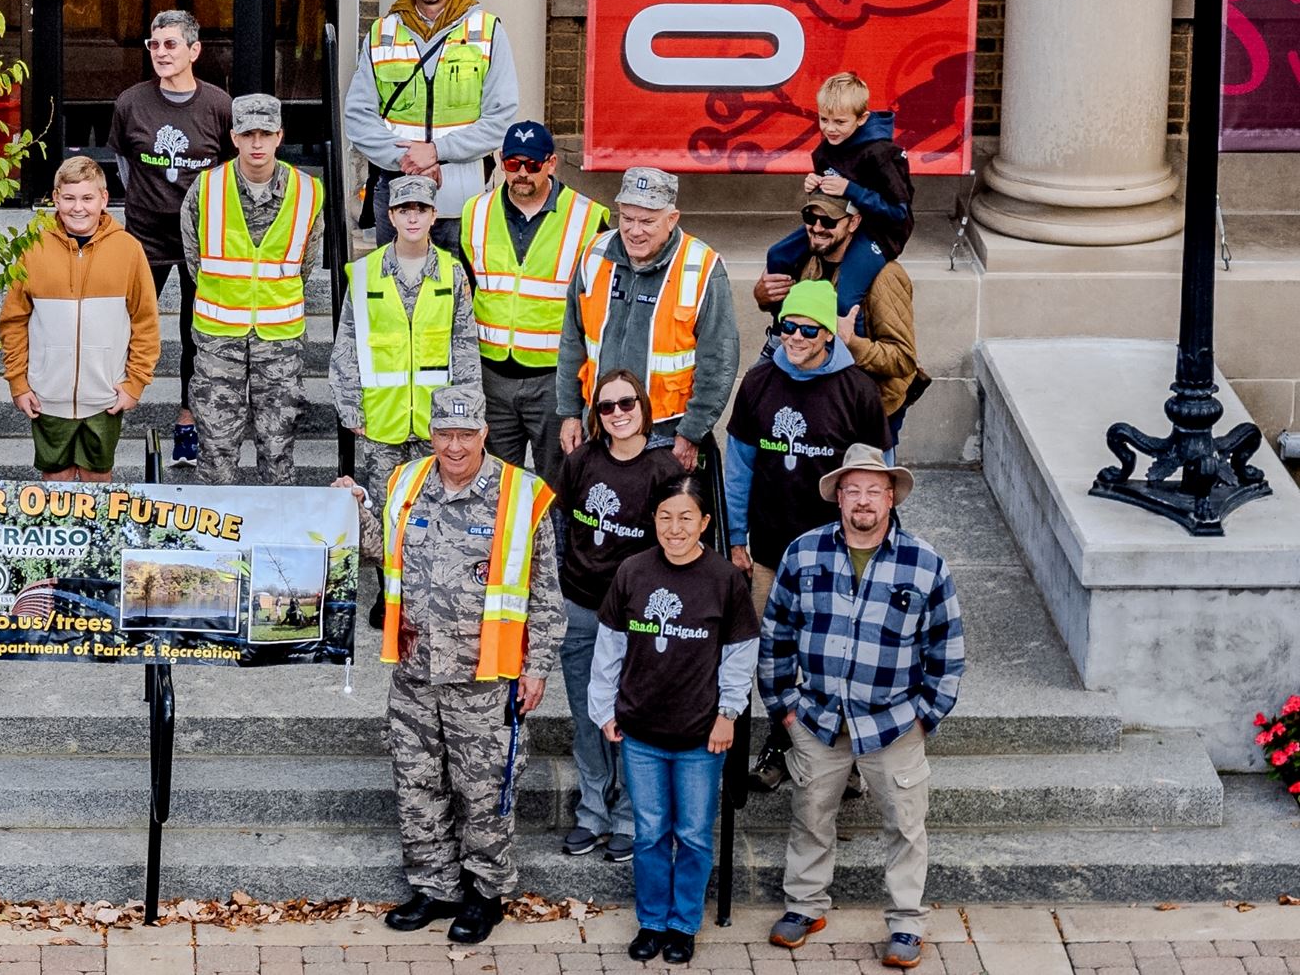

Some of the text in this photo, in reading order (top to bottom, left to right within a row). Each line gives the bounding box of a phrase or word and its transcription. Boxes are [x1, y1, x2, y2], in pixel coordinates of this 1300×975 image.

[140, 153, 211, 169] Shade Brigade
[759, 438, 834, 457] Shade Brigade
[19, 486, 96, 519] OUR
[109, 491, 243, 541] FUTURE
[573, 509, 645, 538] Shade Brigade
[7, 547, 86, 556] VISIONARY
[629, 620, 708, 639] Shade Brigade
[73, 642, 89, 655] of
[94, 644, 138, 657] Parks
[143, 645, 155, 657] &
[161, 645, 241, 660] Recreation
